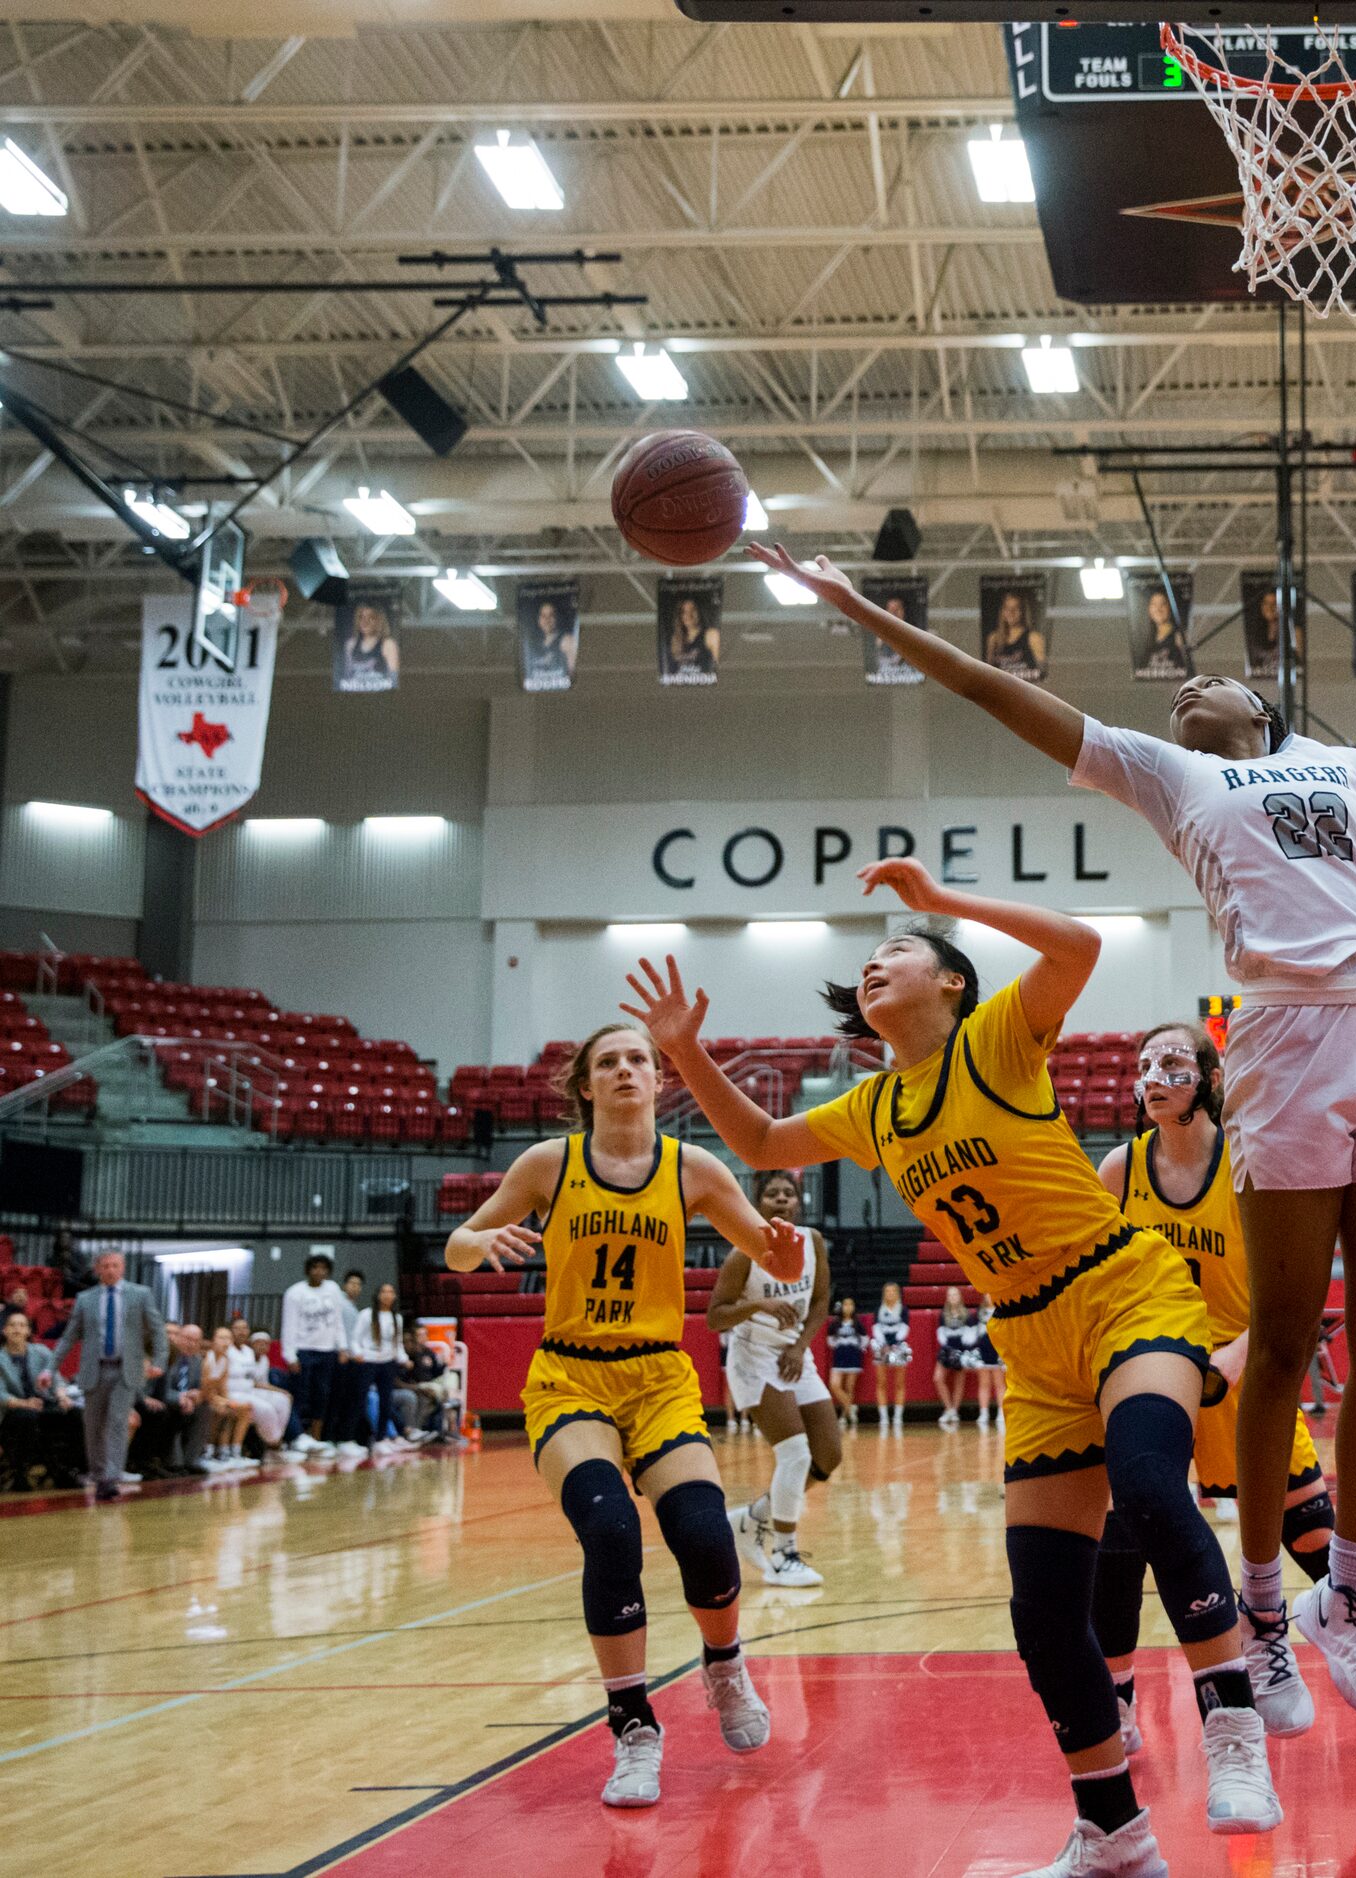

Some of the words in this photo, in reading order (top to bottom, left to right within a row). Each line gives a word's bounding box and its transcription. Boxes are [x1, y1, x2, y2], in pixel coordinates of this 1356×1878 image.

[1213, 36, 1278, 51] PLAYER
[1075, 73, 1132, 88] FOULS
[1079, 57, 1128, 73] TEAM
[1221, 766, 1351, 790] RANGERS
[1262, 791, 1353, 862] 22
[652, 822, 1110, 890] COPPELL
[569, 1210, 669, 1247] HIGHLAND
[935, 1184, 1000, 1244] 13
[1146, 1222, 1226, 1257] HLAND
[591, 1243, 637, 1290] 14
[585, 1298, 635, 1323] PARK
